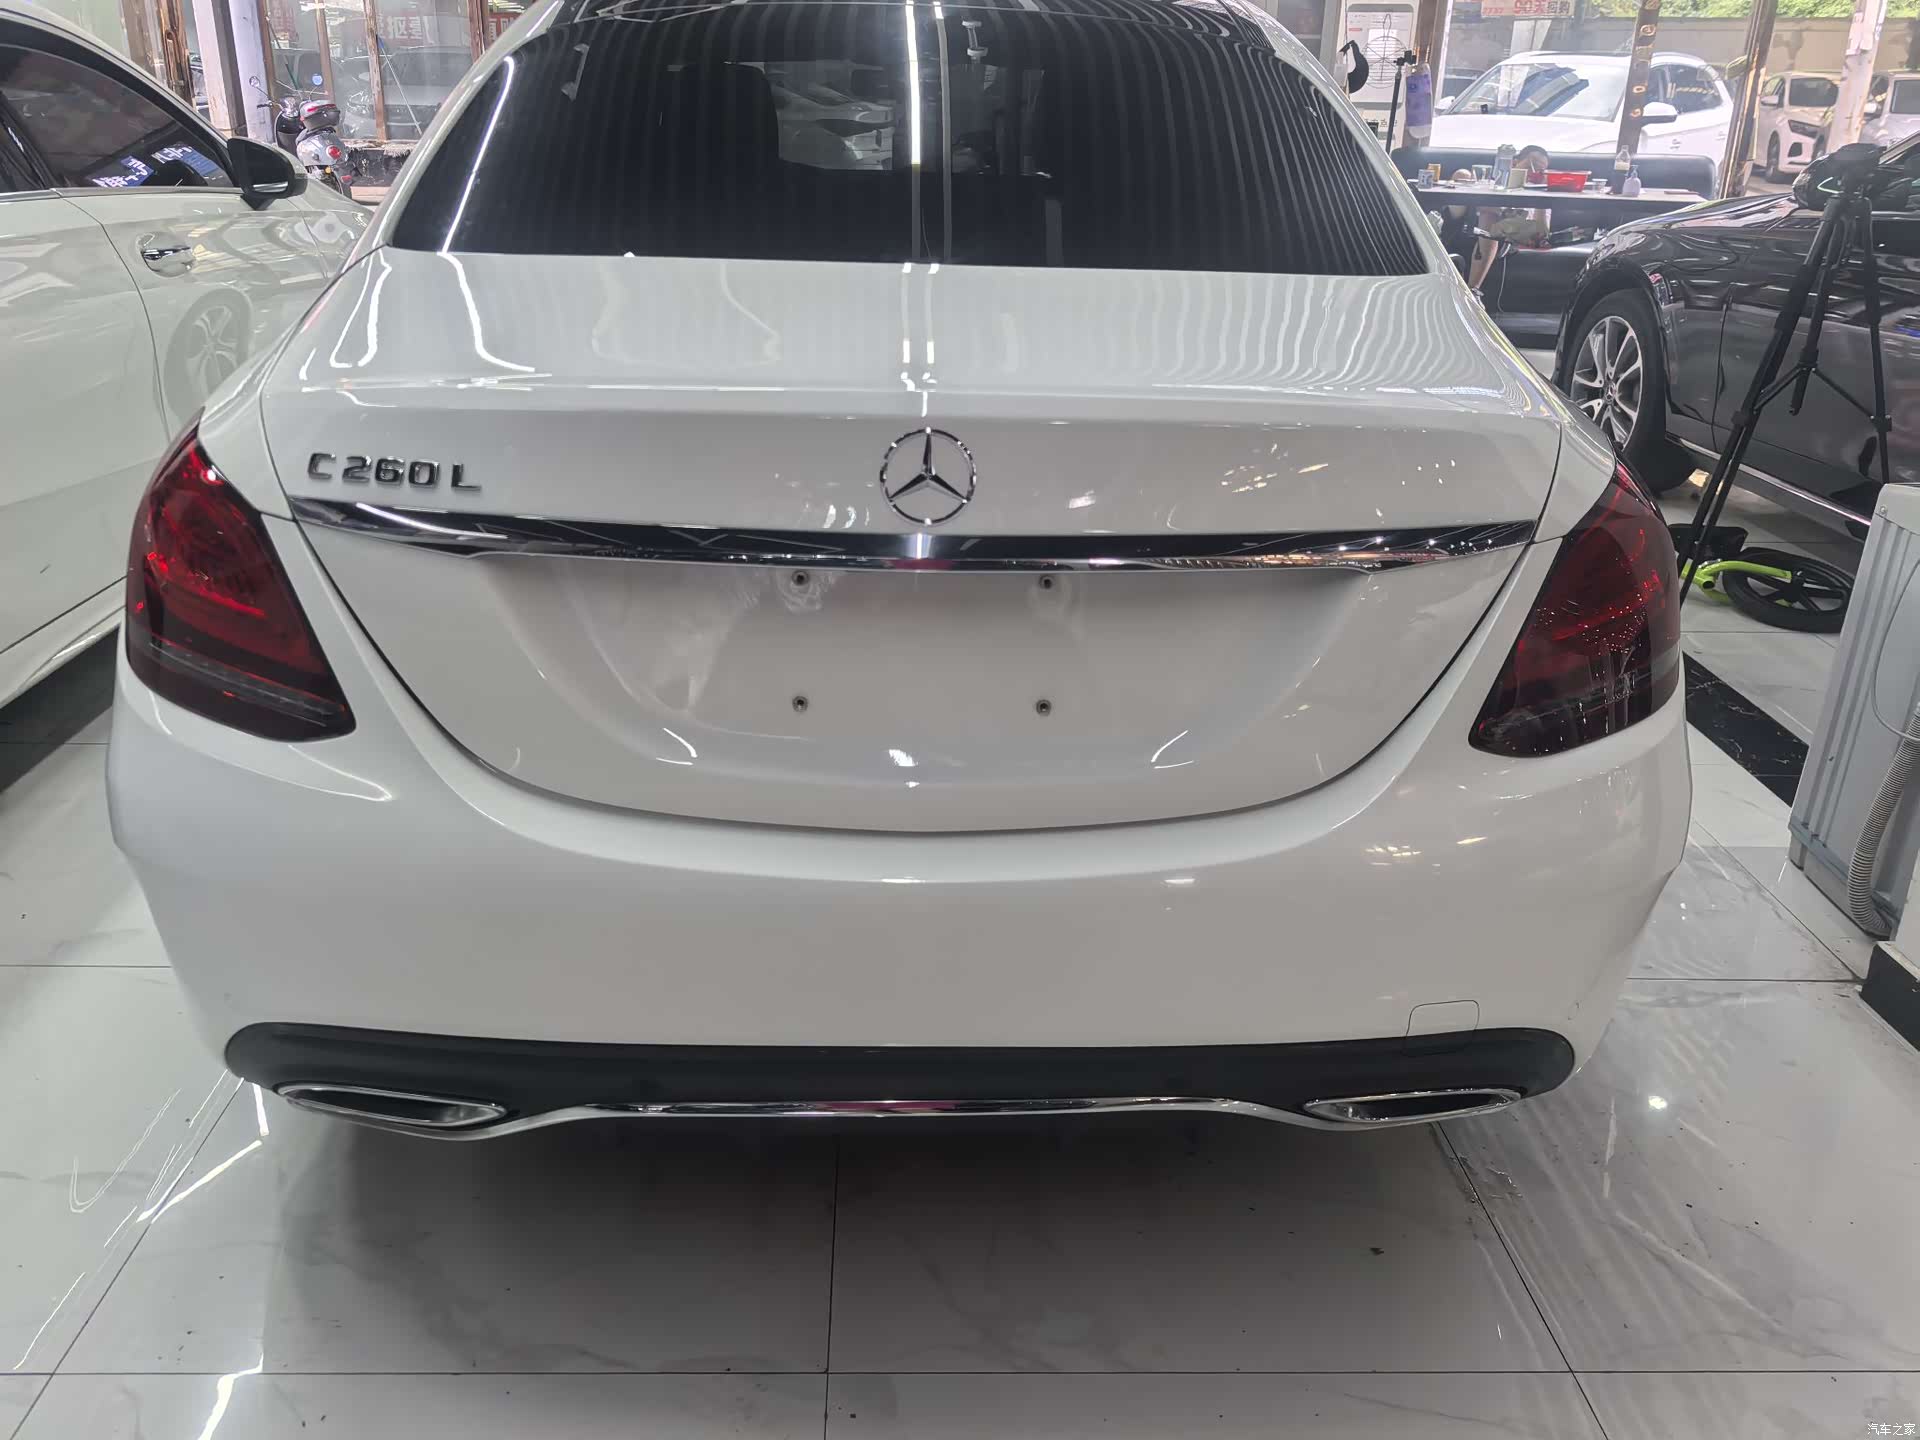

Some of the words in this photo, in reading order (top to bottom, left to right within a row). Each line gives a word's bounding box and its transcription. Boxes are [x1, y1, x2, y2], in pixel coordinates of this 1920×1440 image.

[307, 452, 336, 480] C
[342, 455, 441, 487] 260
[450, 463, 482, 491] L
